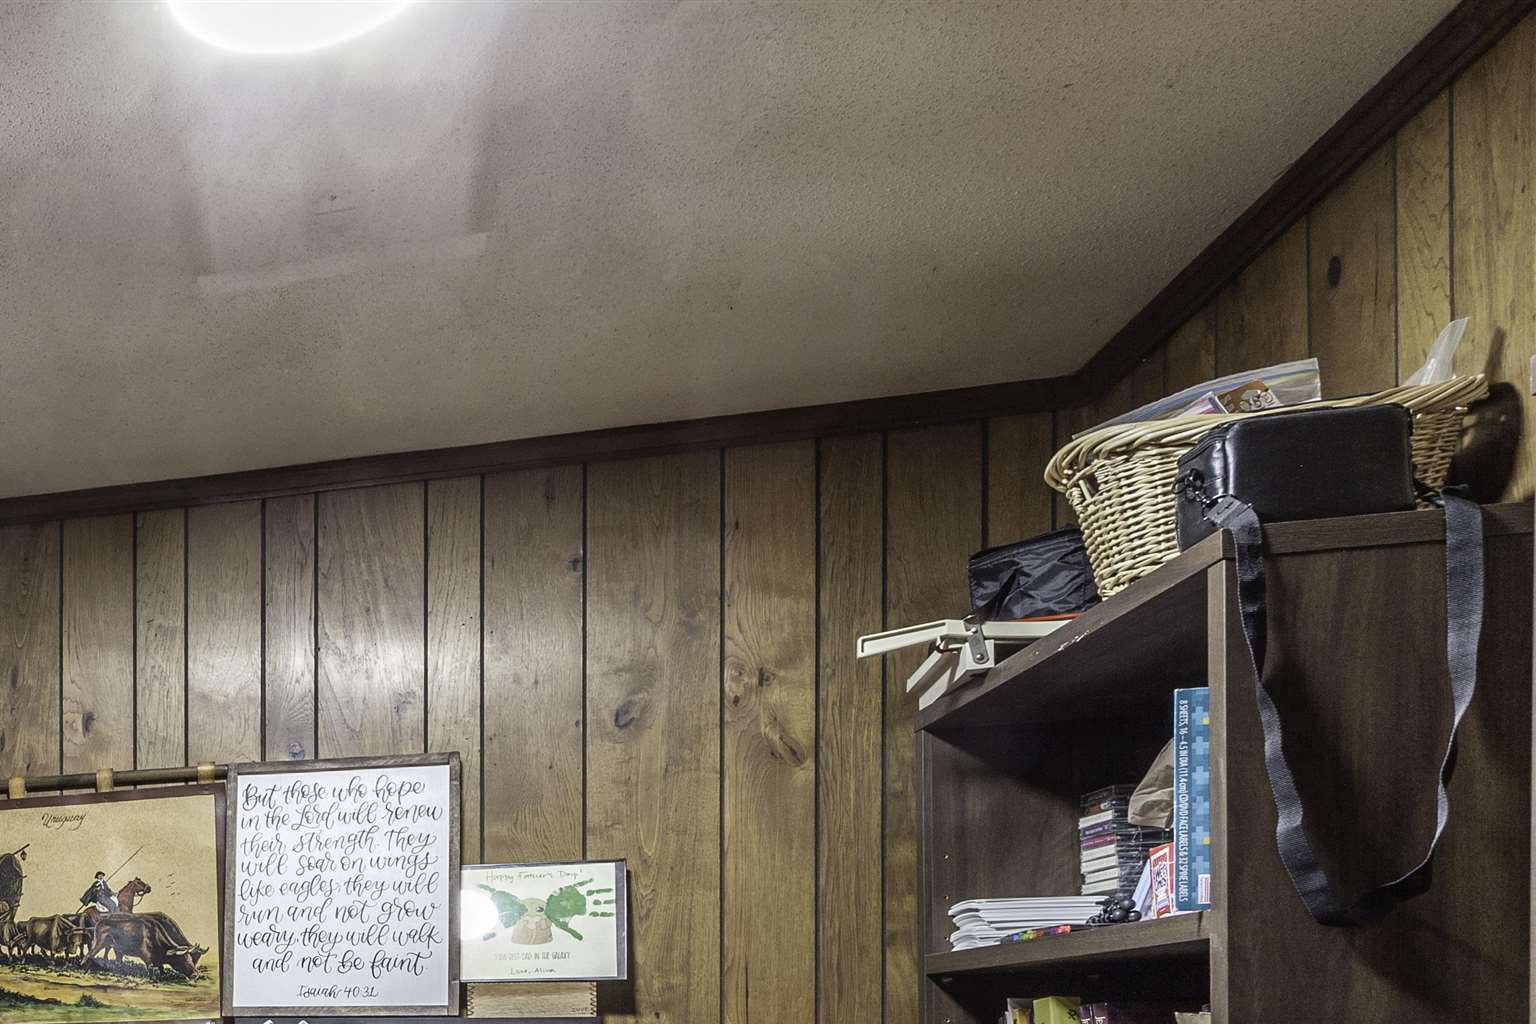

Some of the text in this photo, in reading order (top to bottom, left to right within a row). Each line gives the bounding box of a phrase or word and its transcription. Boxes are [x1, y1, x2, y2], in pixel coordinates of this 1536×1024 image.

[243, 775, 425, 811] But those who hope
[41, 812, 86, 831] Uruguay
[241, 798, 443, 830] in the Lord will renew
[241, 833, 284, 858] their
[385, 827, 437, 854] They
[1179, 831, 1188, 850] LABELS
[241, 852, 438, 877] will soar on wings
[486, 871, 513, 882] Happy
[1179, 865, 1188, 881] SPINE
[239, 872, 439, 906] like they will
[1179, 881, 1188, 902] LABELS
[238, 898, 441, 925] run and not grow
[300, 924, 343, 952] they
[346, 924, 390, 945] will
[392, 922, 443, 948] walk
[252, 951, 293, 973] and
[297, 950, 337, 973] not
[337, 950, 364, 973] be
[297, 985, 341, 998] Isaiah
